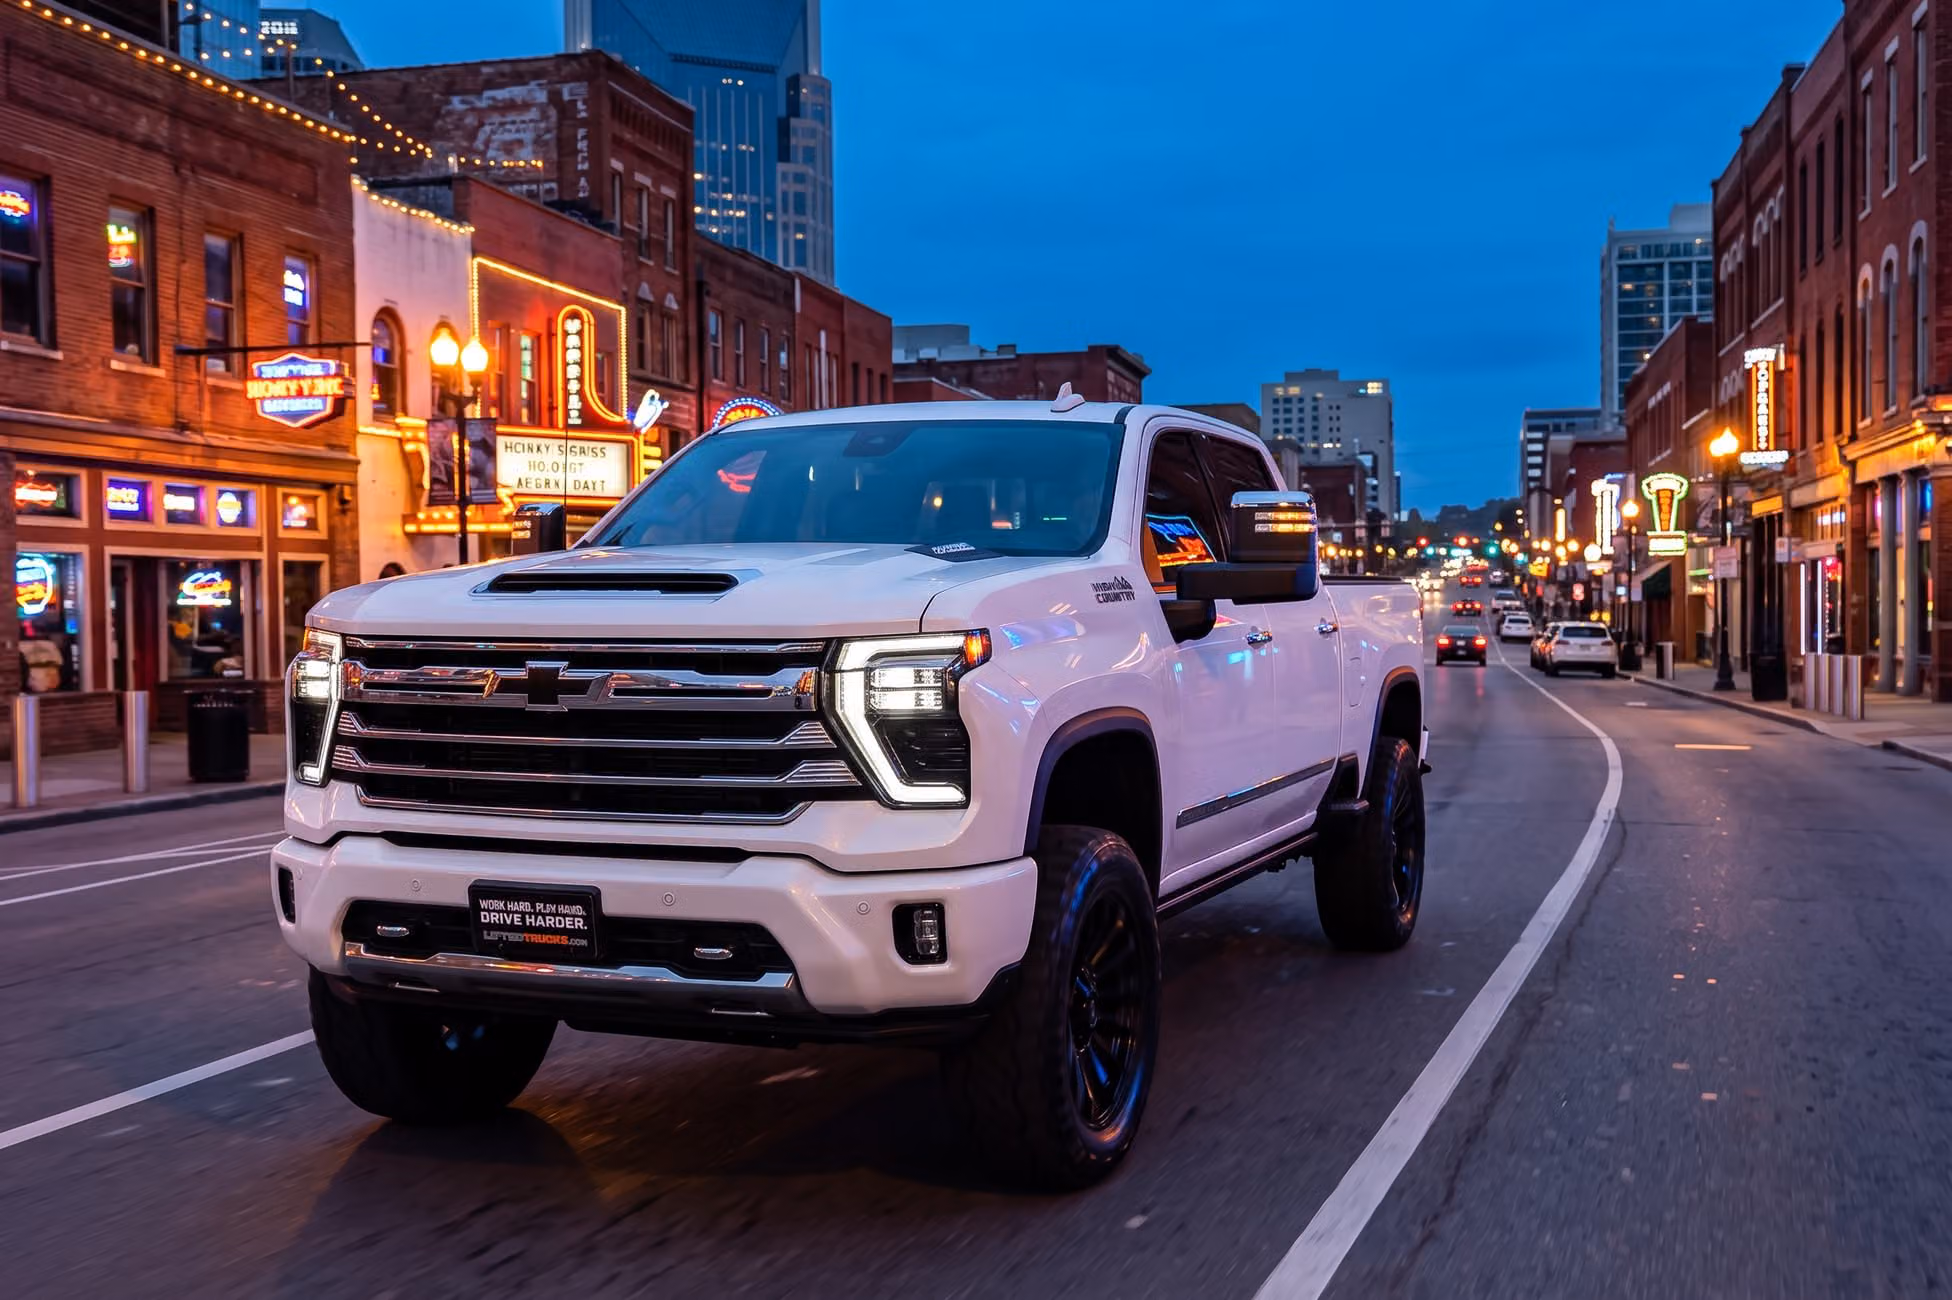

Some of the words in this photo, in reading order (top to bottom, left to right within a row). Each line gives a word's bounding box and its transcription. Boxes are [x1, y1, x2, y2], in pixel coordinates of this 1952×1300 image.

[507, 901, 534, 913] HARD.
[480, 911, 523, 926] DRIVE
[525, 914, 588, 930] HARDER.
